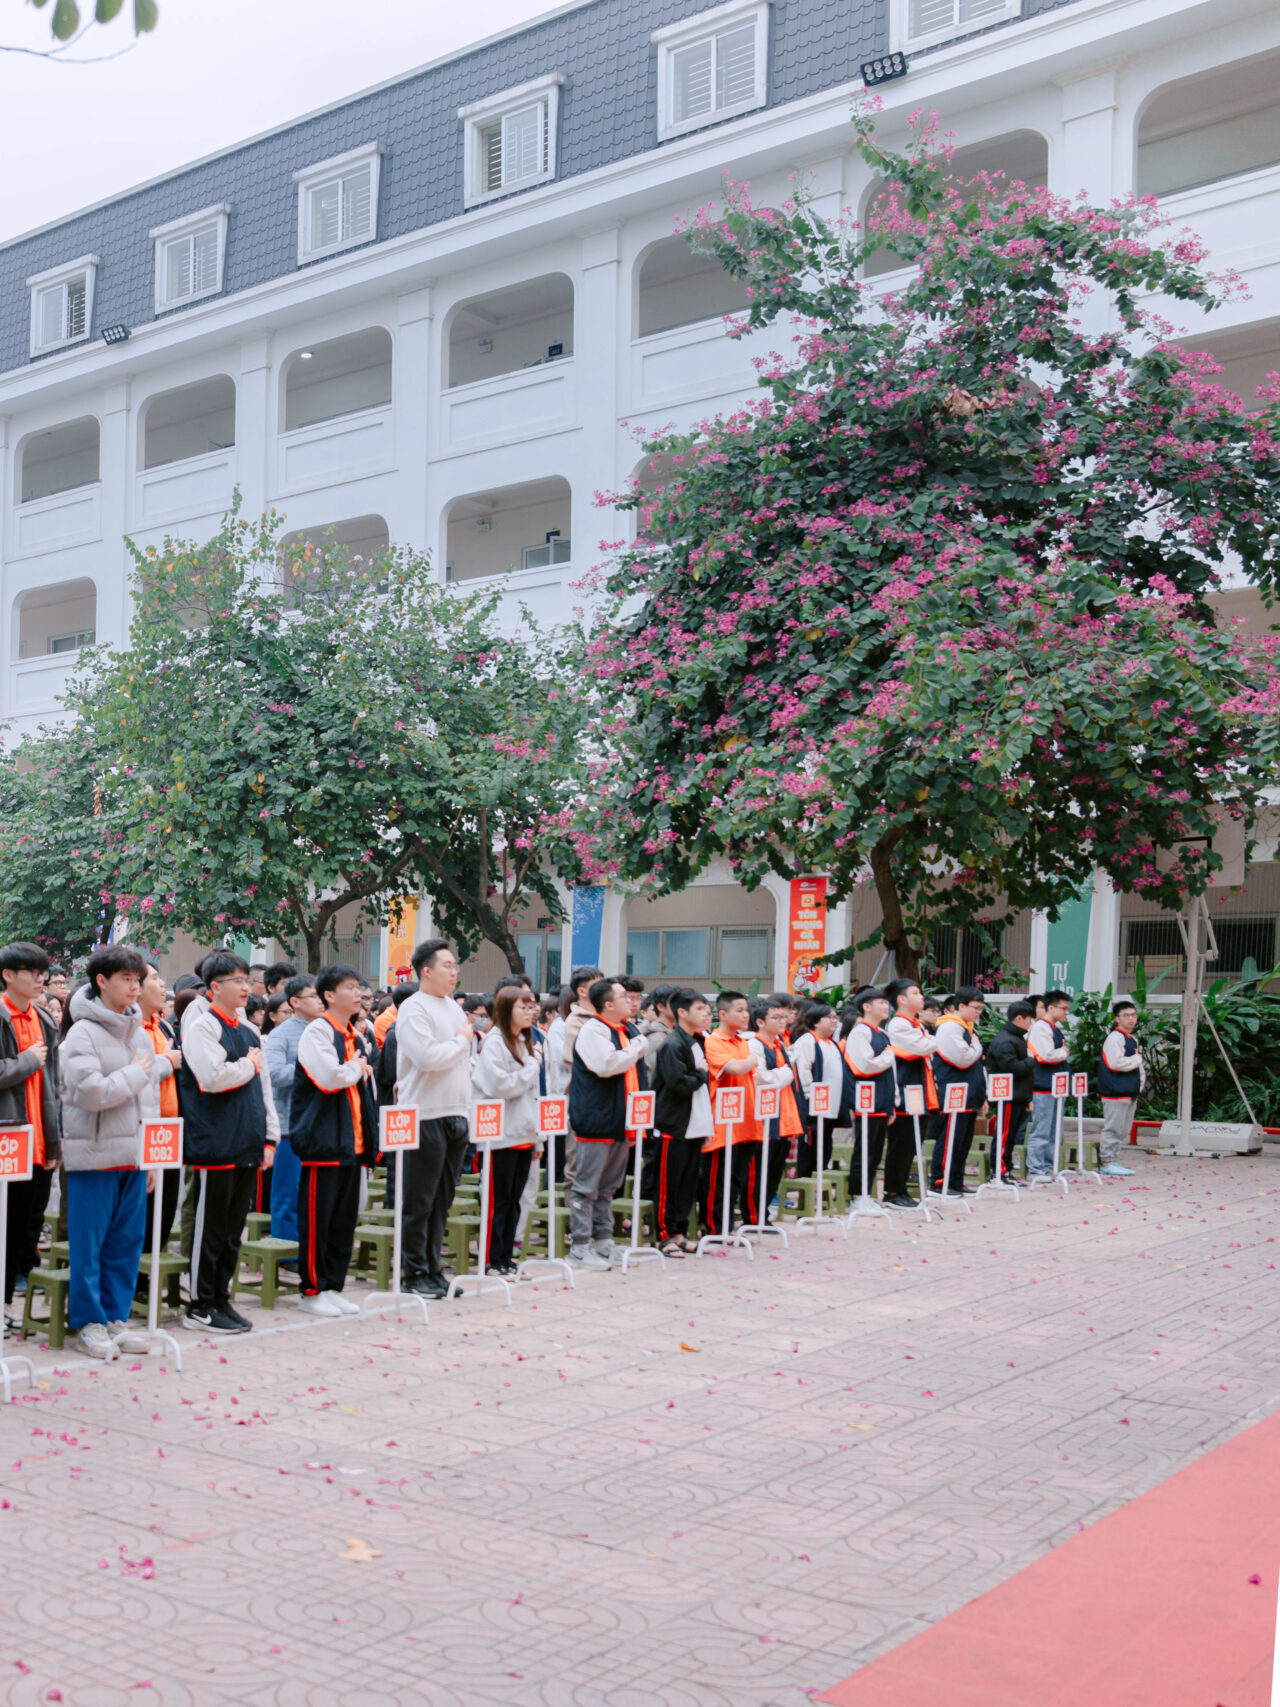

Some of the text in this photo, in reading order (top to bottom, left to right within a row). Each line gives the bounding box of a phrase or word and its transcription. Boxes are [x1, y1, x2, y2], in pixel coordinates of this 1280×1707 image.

[480, 1106, 497, 1122] LỚP
[544, 1103, 561, 1117] LỚP
[390, 1112, 410, 1129] LỚP
[543, 1117, 561, 1129] 10C1
[150, 1127, 173, 1145] LỚP
[388, 1129, 412, 1143] 10B4
[149, 1145, 173, 1162] 10B2
